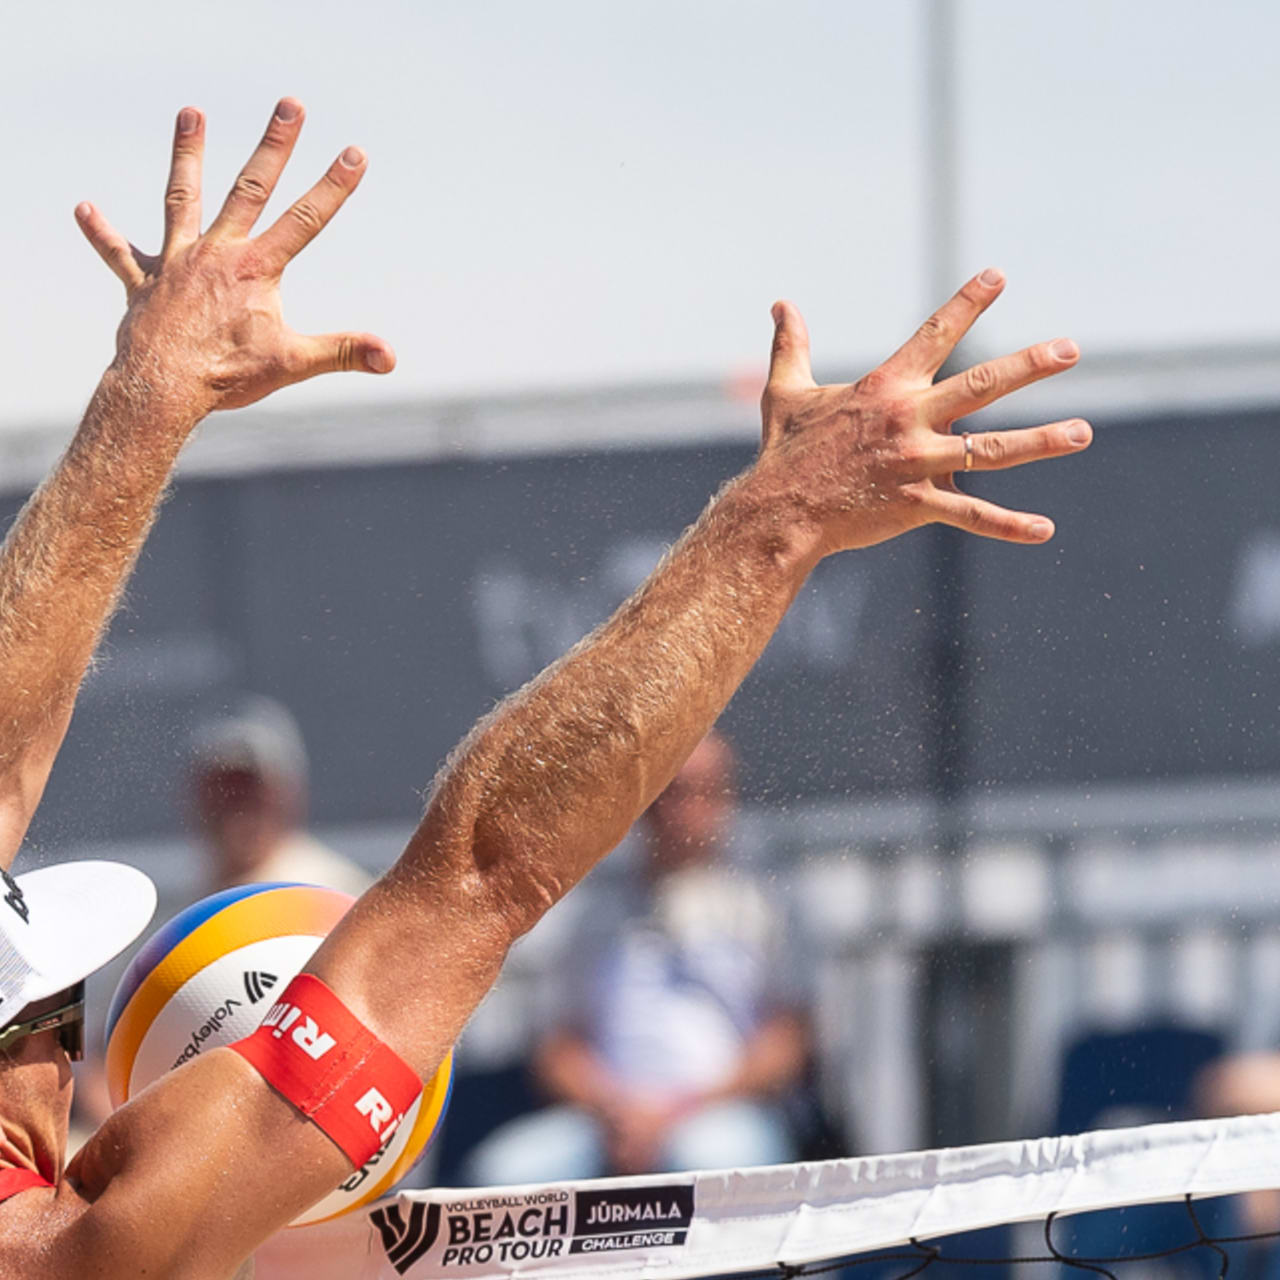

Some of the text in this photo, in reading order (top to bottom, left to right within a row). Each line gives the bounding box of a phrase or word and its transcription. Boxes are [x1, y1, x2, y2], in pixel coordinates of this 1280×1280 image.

[446, 1191, 569, 1212] VOLLEYBALL WORLD
[448, 1205, 568, 1246] BEACH
[442, 1239, 563, 1267] PRO TOUR
[581, 1232, 675, 1251] CHALLENGE
